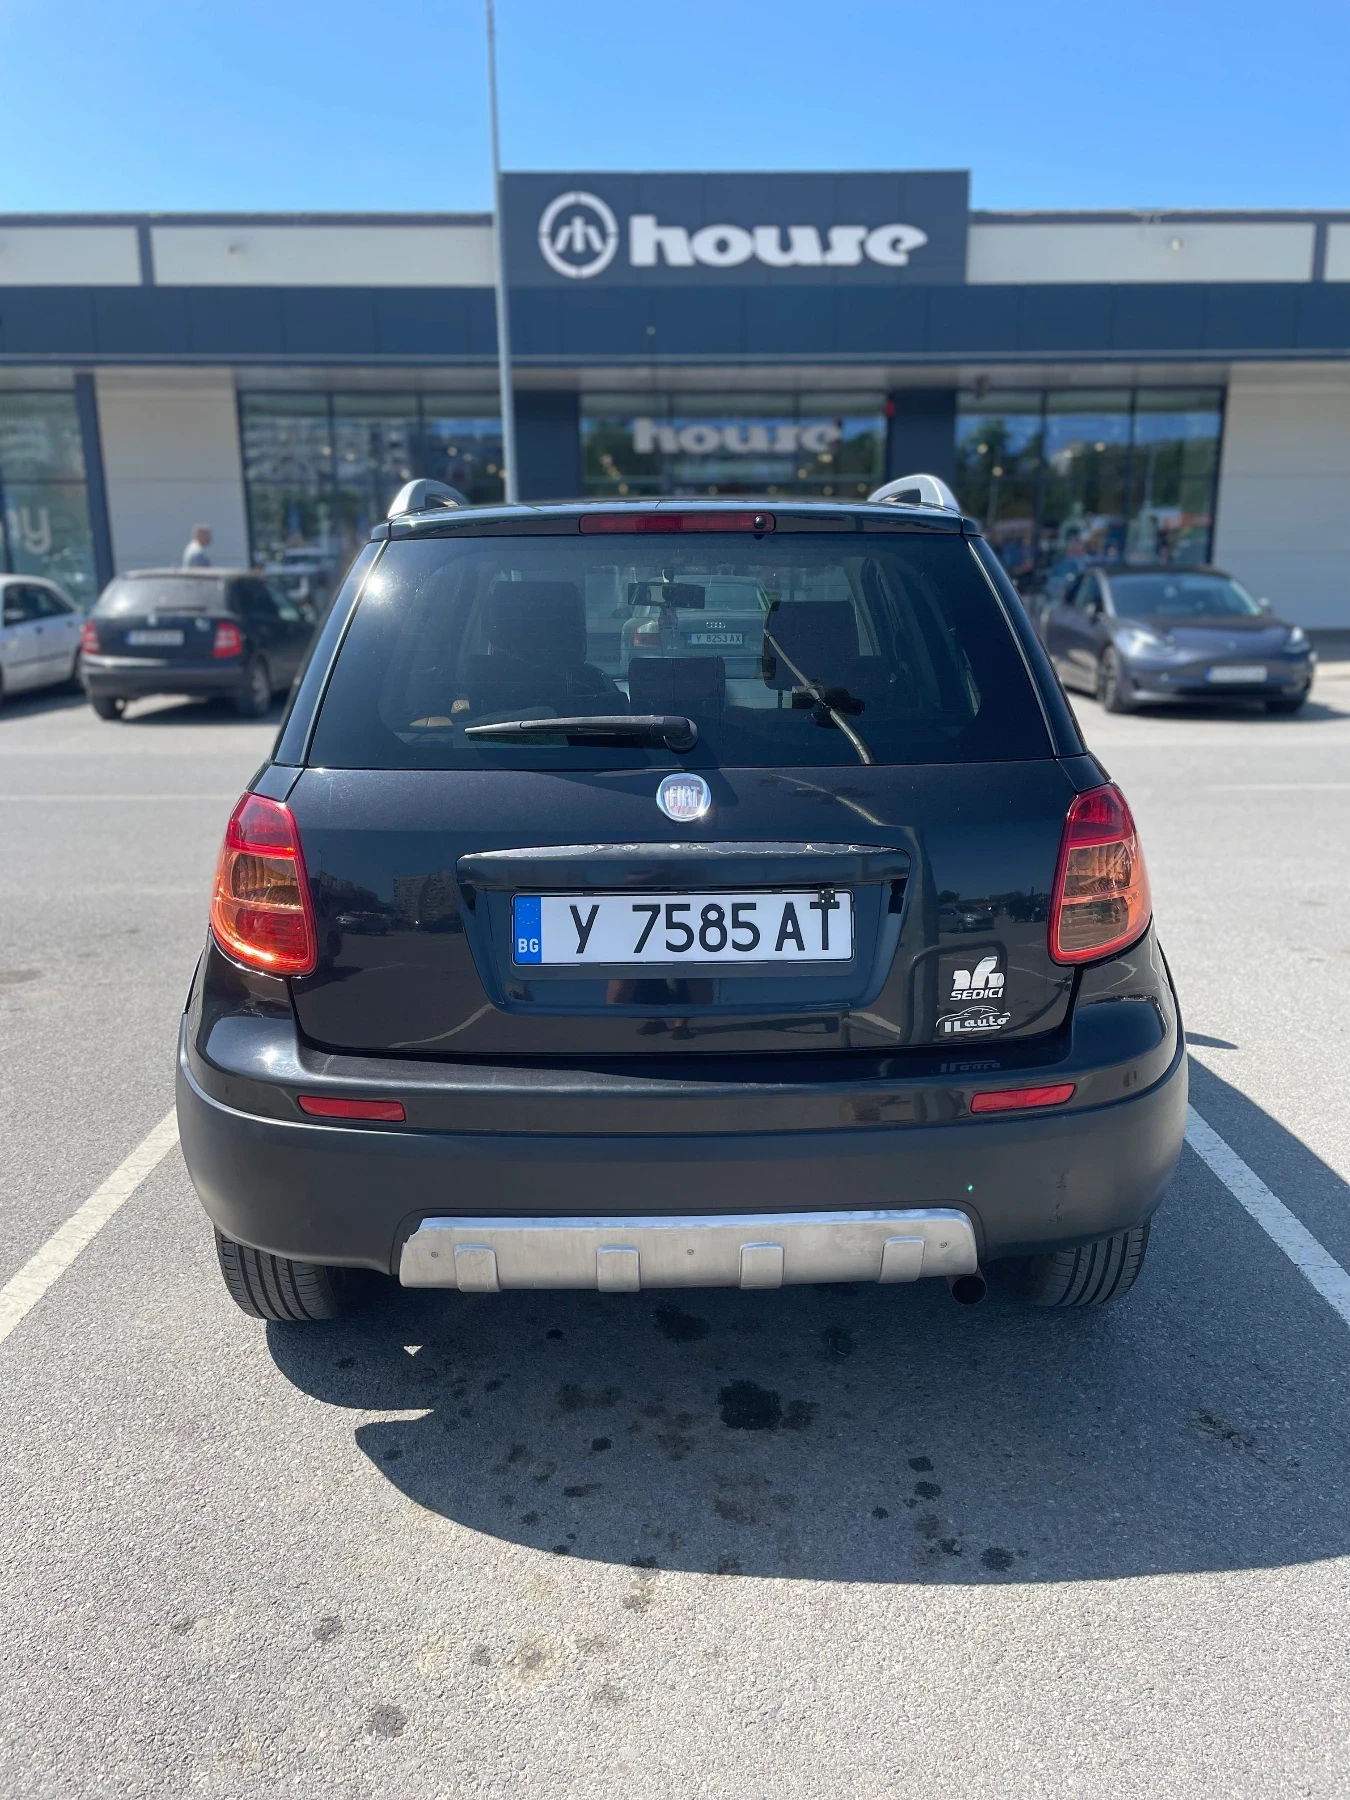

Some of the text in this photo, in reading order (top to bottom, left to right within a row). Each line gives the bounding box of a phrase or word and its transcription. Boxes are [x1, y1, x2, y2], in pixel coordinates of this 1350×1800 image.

[630, 215, 928, 267] house
[632, 416, 841, 454] house
[706, 634, 728, 643] 8253
[669, 785, 700, 807] FIAT
[569, 901, 840, 954] Y 7585 AT
[517, 938, 539, 953] BG
[950, 988, 1004, 1000] SEDICI
